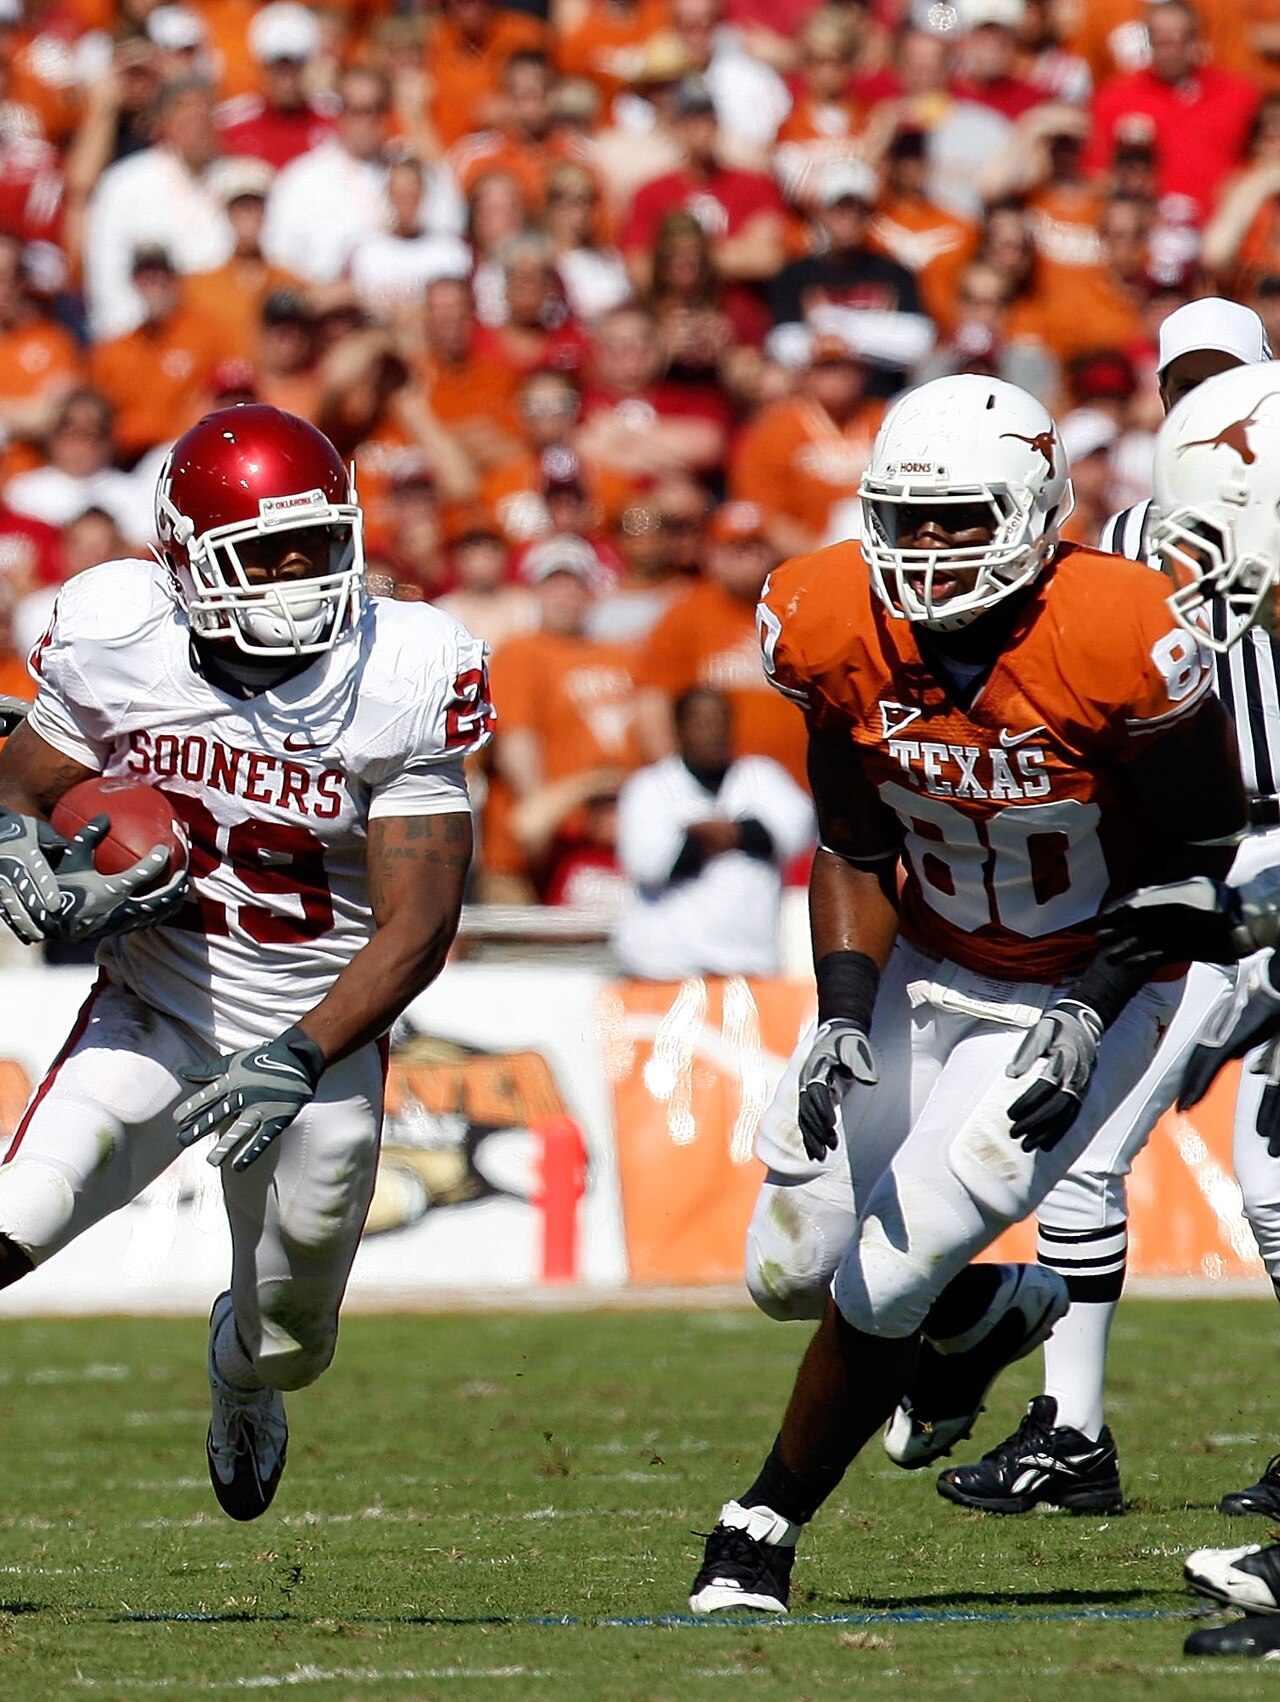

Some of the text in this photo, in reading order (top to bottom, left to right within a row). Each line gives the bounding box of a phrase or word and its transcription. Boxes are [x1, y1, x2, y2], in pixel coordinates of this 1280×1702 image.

[900, 462, 932, 473] HORNS
[275, 497, 312, 510] OKLAHOMA
[128, 729, 345, 819] SOONERS
[888, 739, 1052, 799] TEXAS
[878, 780, 1111, 938] 80
